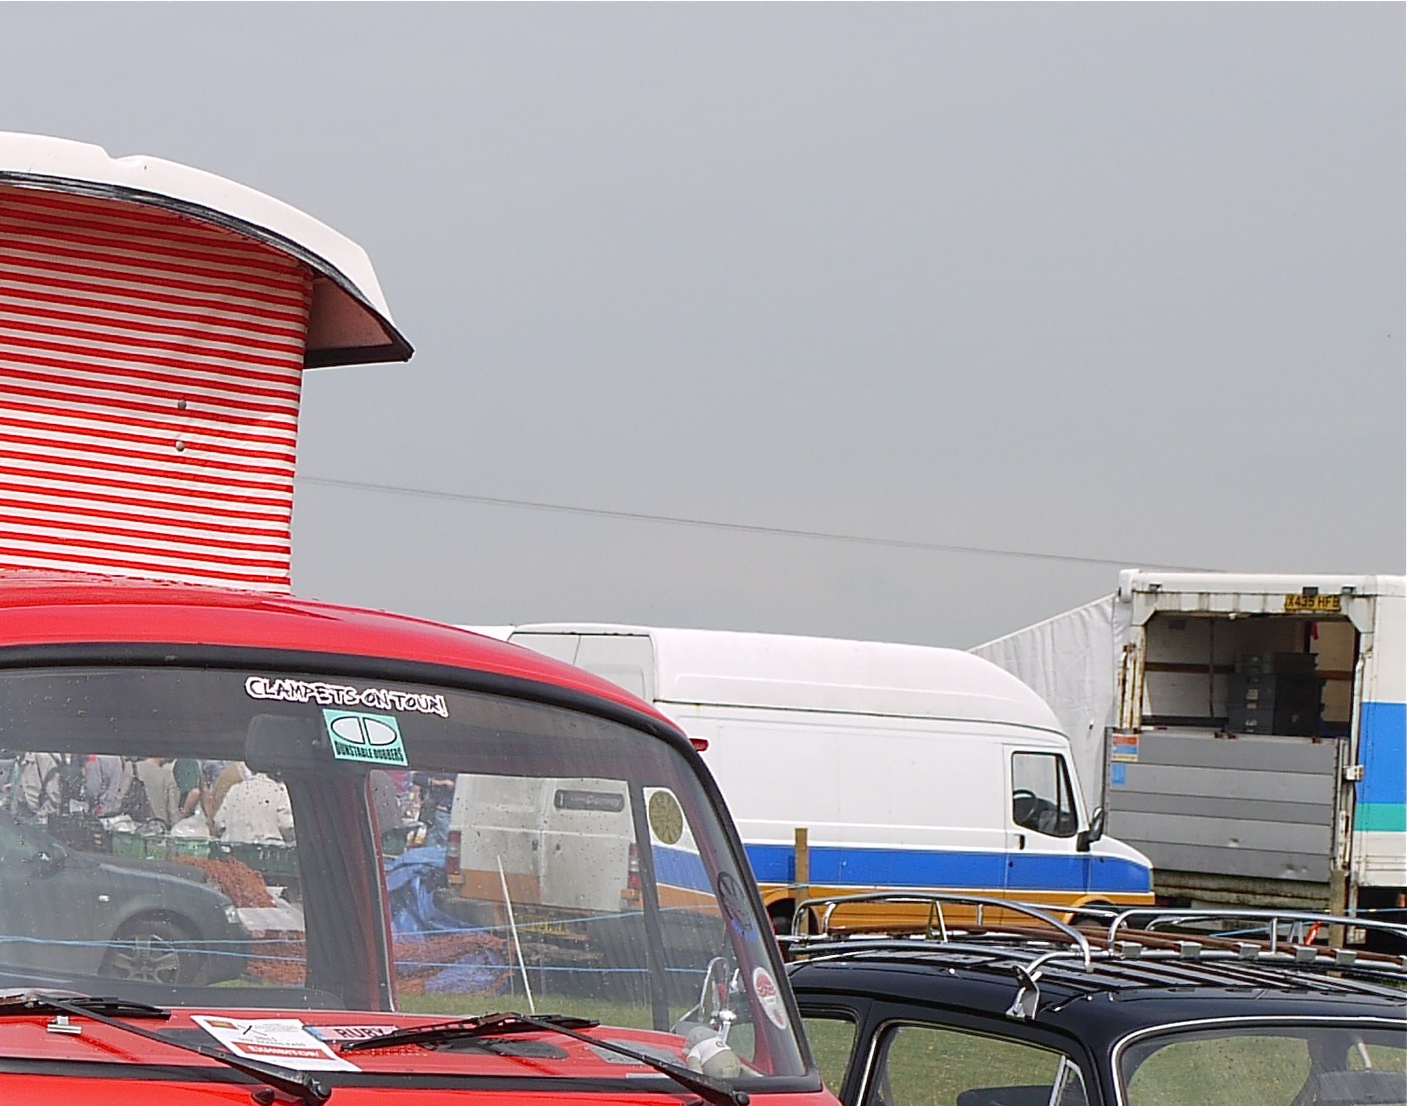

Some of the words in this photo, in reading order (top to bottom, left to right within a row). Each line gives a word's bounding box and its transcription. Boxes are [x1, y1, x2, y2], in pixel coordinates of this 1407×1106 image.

[247, 679, 358, 704] CLAMPETS
[363, 689, 390, 709] ON
[333, 1028, 384, 1038] RUBY
